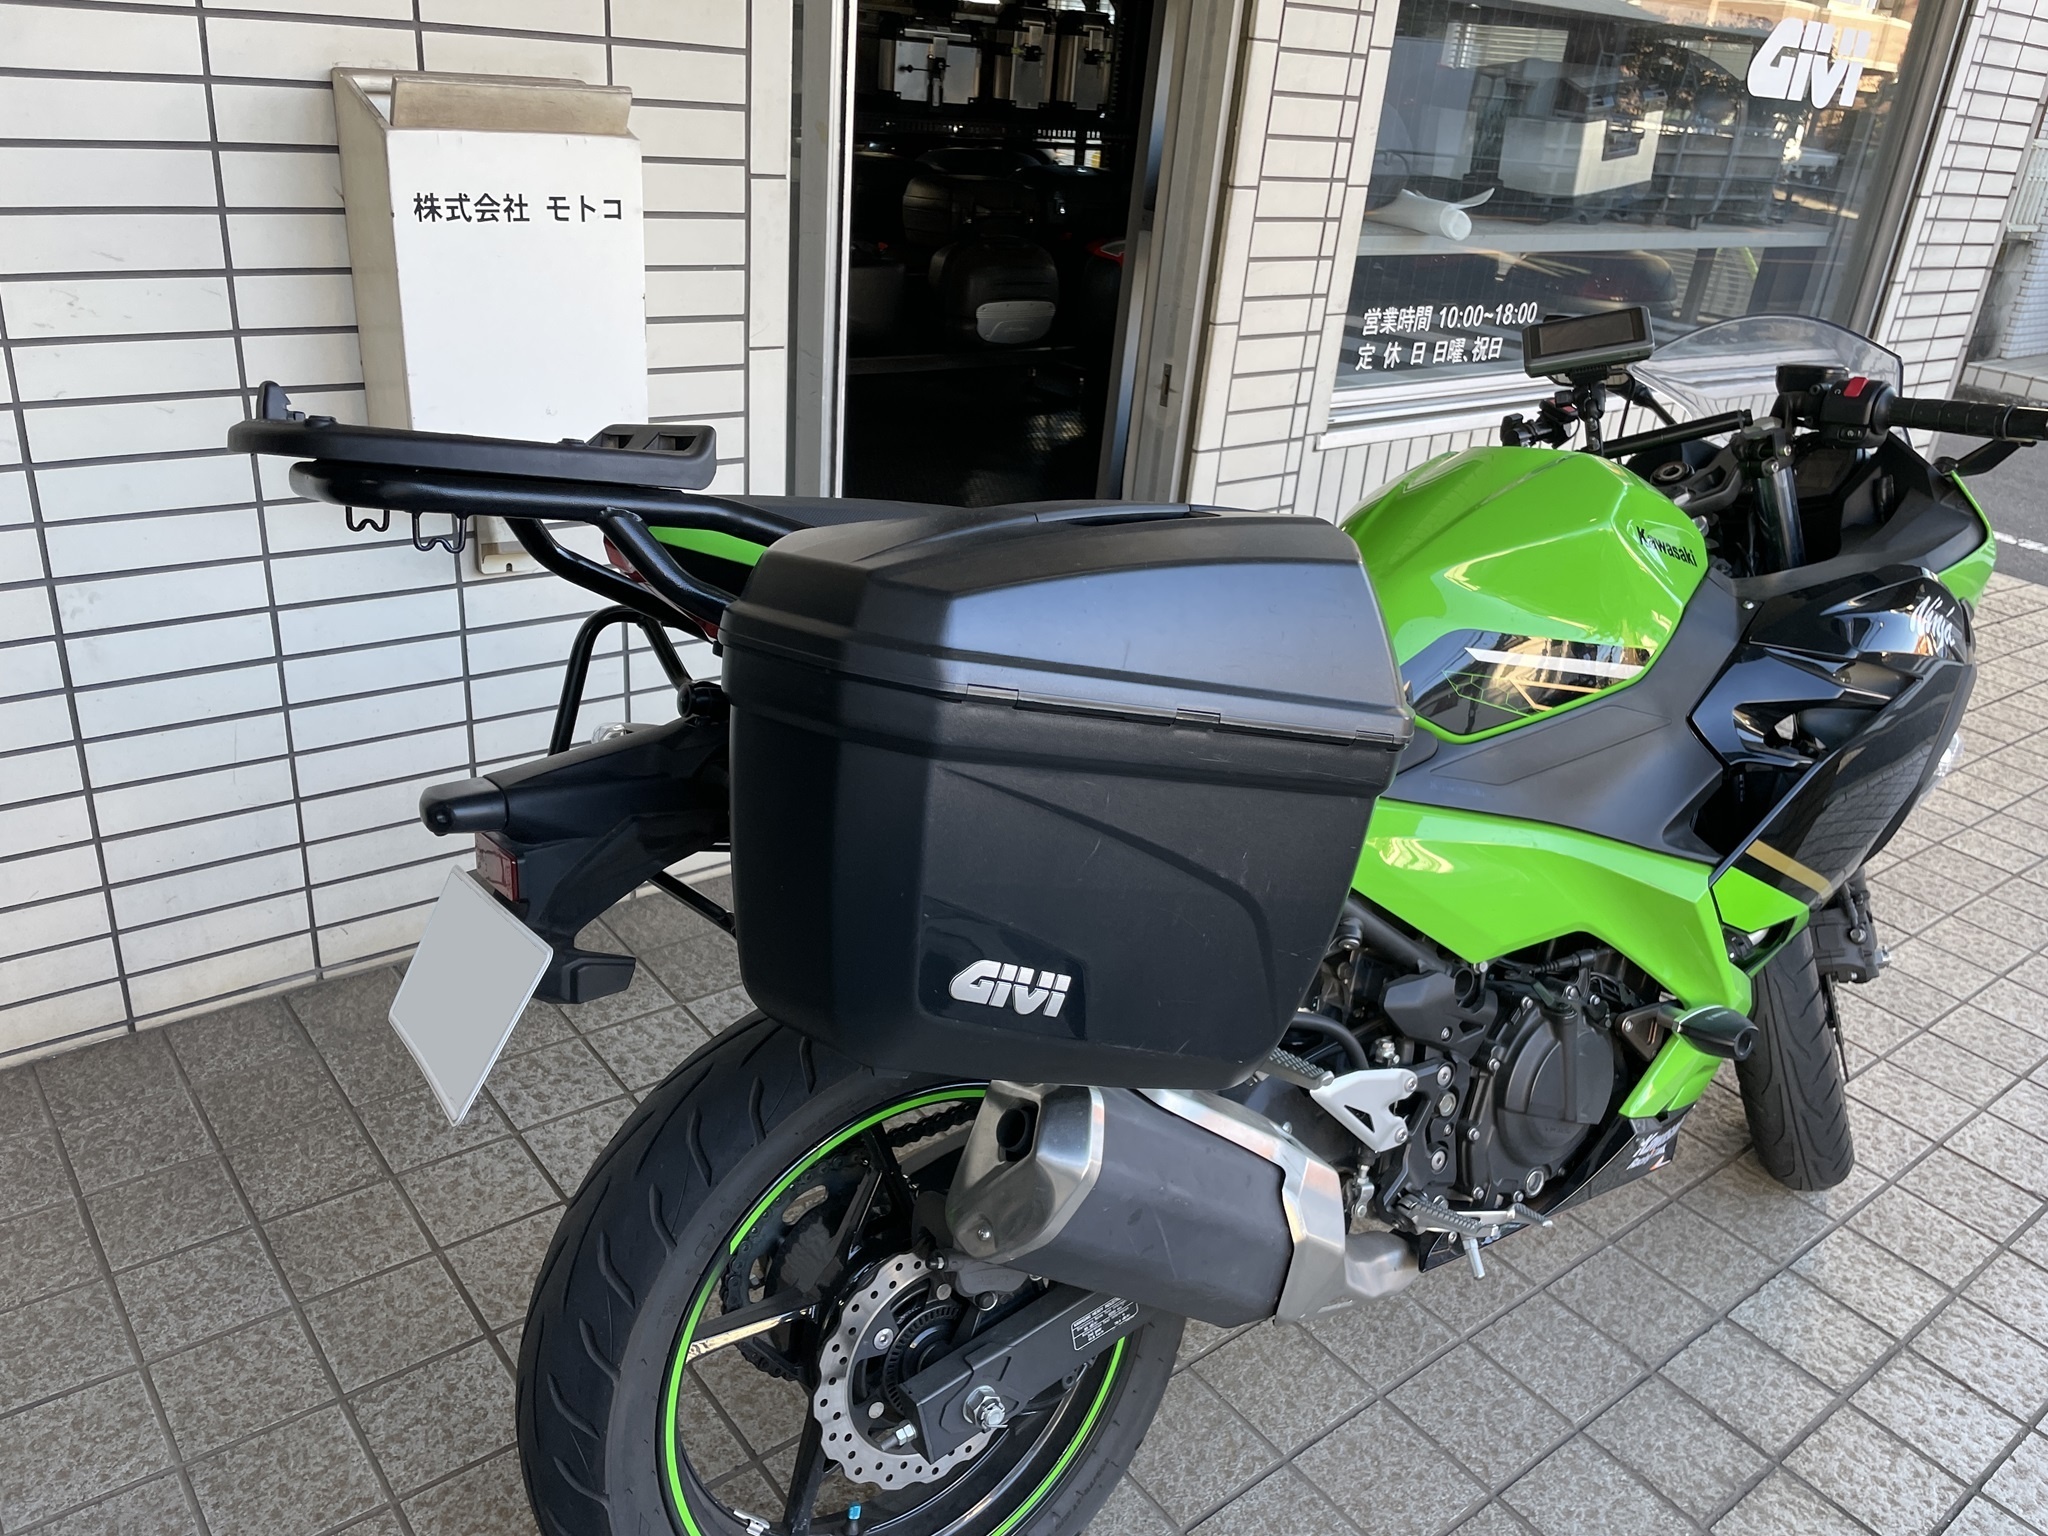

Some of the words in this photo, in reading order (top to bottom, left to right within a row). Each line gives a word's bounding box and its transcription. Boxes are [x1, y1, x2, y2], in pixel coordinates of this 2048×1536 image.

[1747, 17, 1872, 109] GIVI
[413, 192, 531, 223] 株式会社
[546, 195, 622, 223] モトコ
[1362, 305, 1434, 336] 営業時間
[1636, 525, 1698, 568] Kawasaki
[1910, 595, 1956, 651] Ninja
[949, 959, 1072, 1018] GIVI
